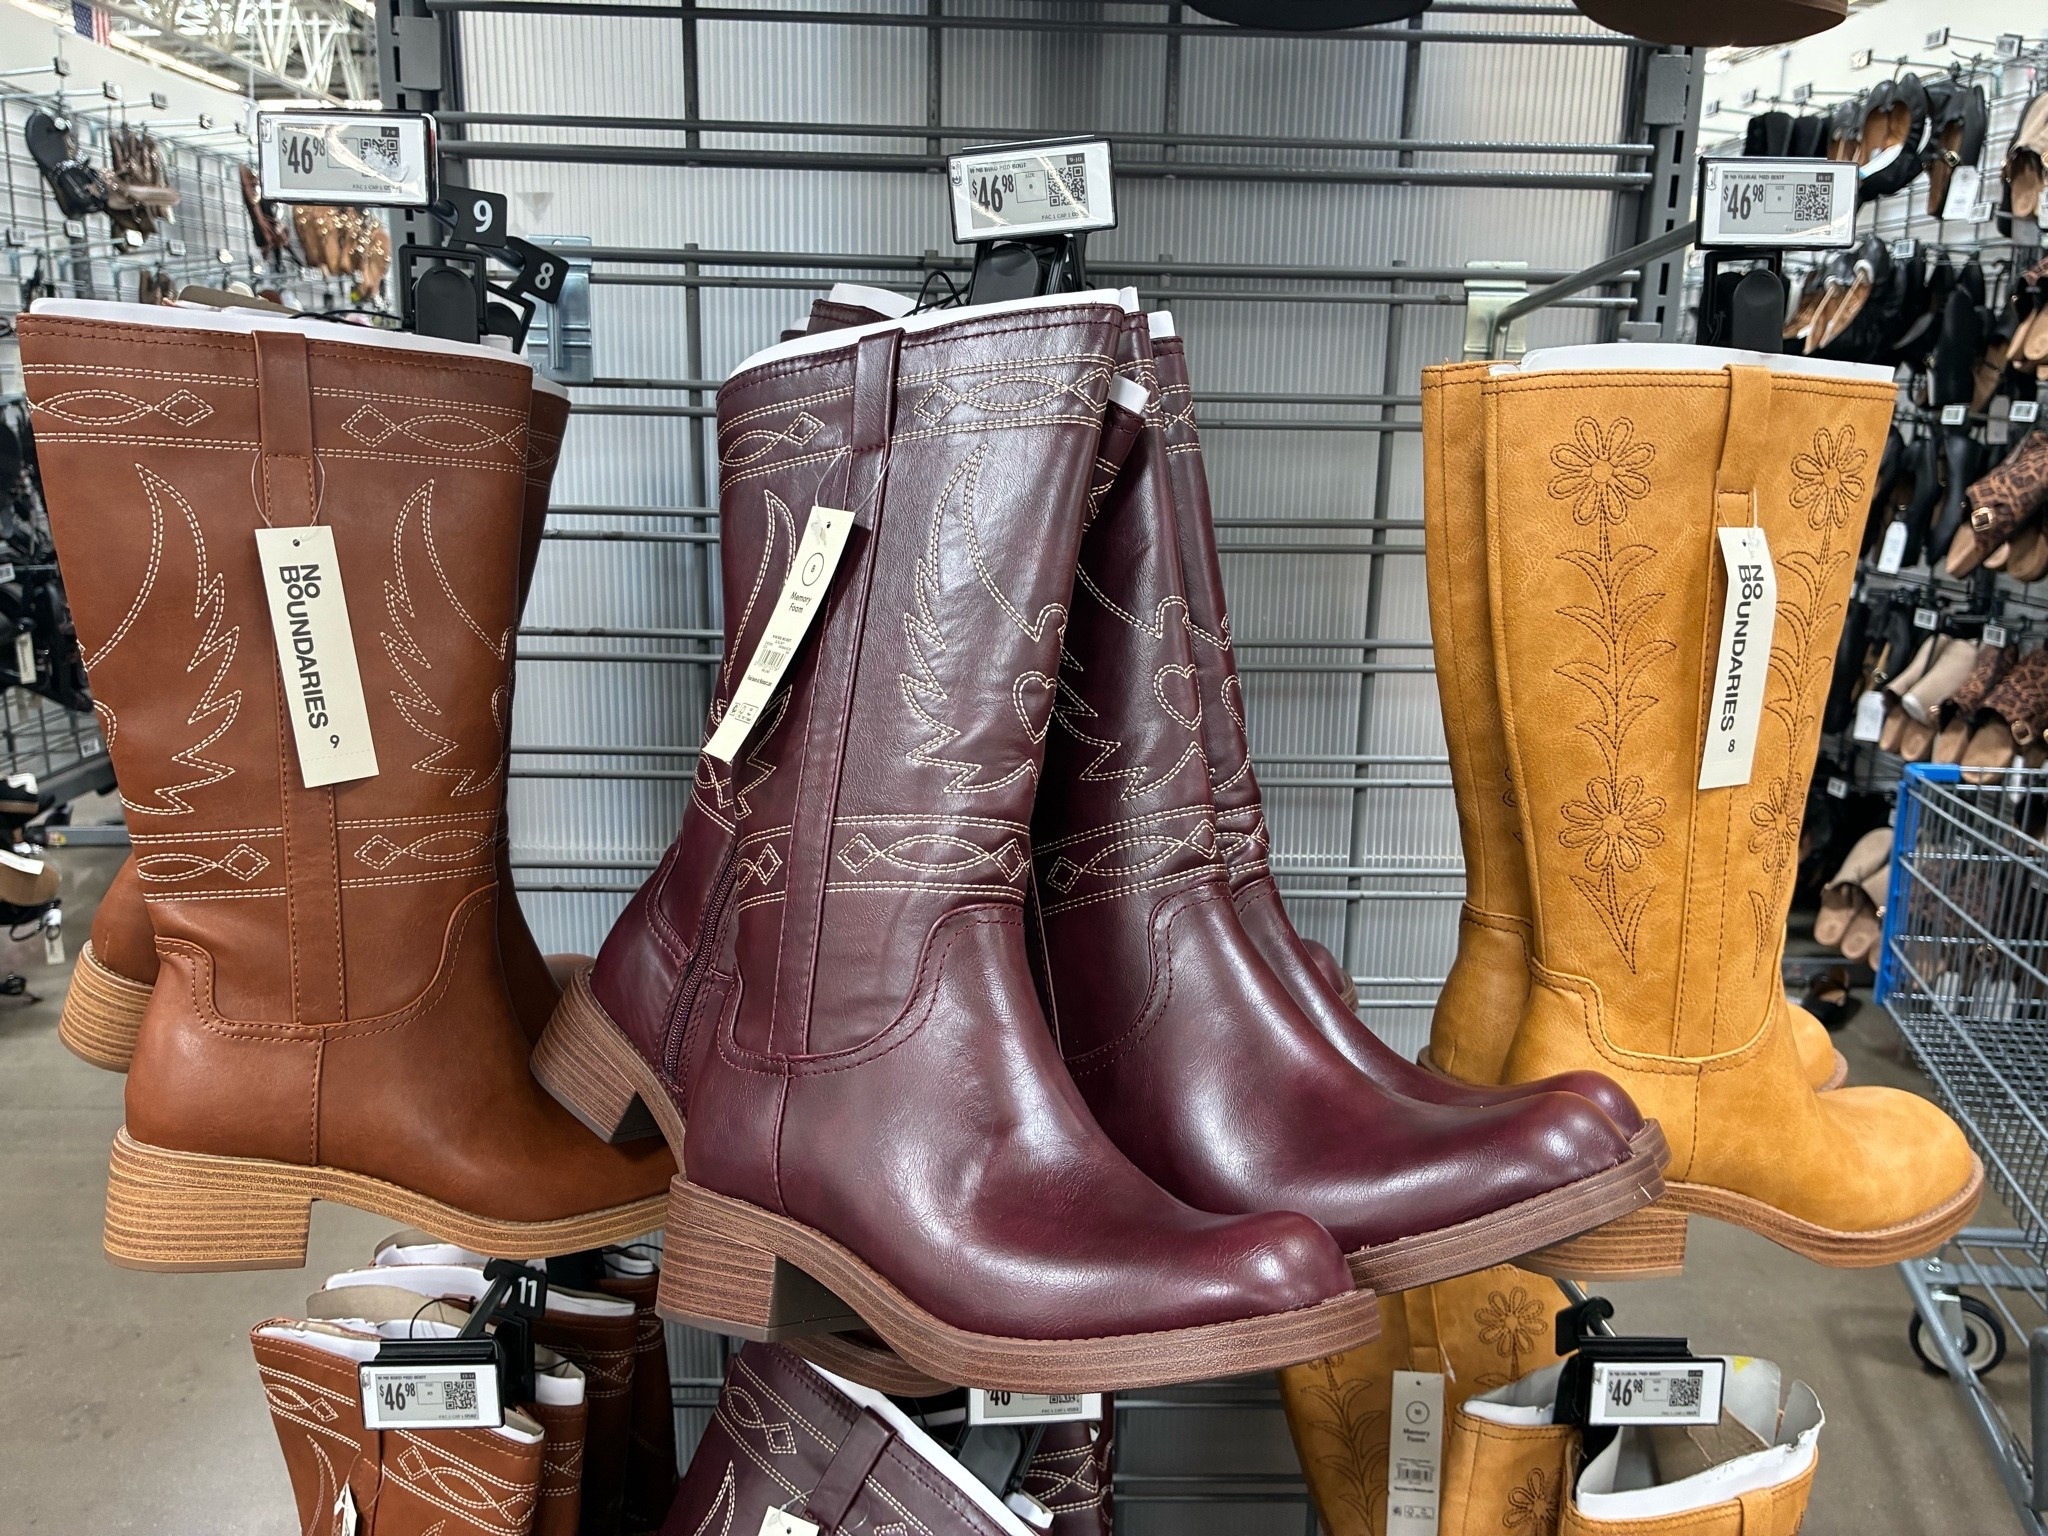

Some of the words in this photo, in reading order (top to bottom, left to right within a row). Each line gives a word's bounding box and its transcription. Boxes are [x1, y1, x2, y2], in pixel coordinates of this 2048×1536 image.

[473, 200, 493, 232] 9
[534, 262, 554, 290] 8
[299, 563, 322, 599] NO
[1750, 564, 1764, 600] NO
[789, 602, 803, 614] Foam
[790, 591, 813, 606] Memory
[279, 565, 329, 729] BOUNDARIES
[1720, 564, 1751, 732] BOUNDARIES
[329, 734, 340, 749] 9
[1727, 738, 1736, 753] 8
[518, 1276, 538, 1308] 11
[1403, 1428, 1430, 1438] Memory
[1407, 1435, 1426, 1443] Foam
